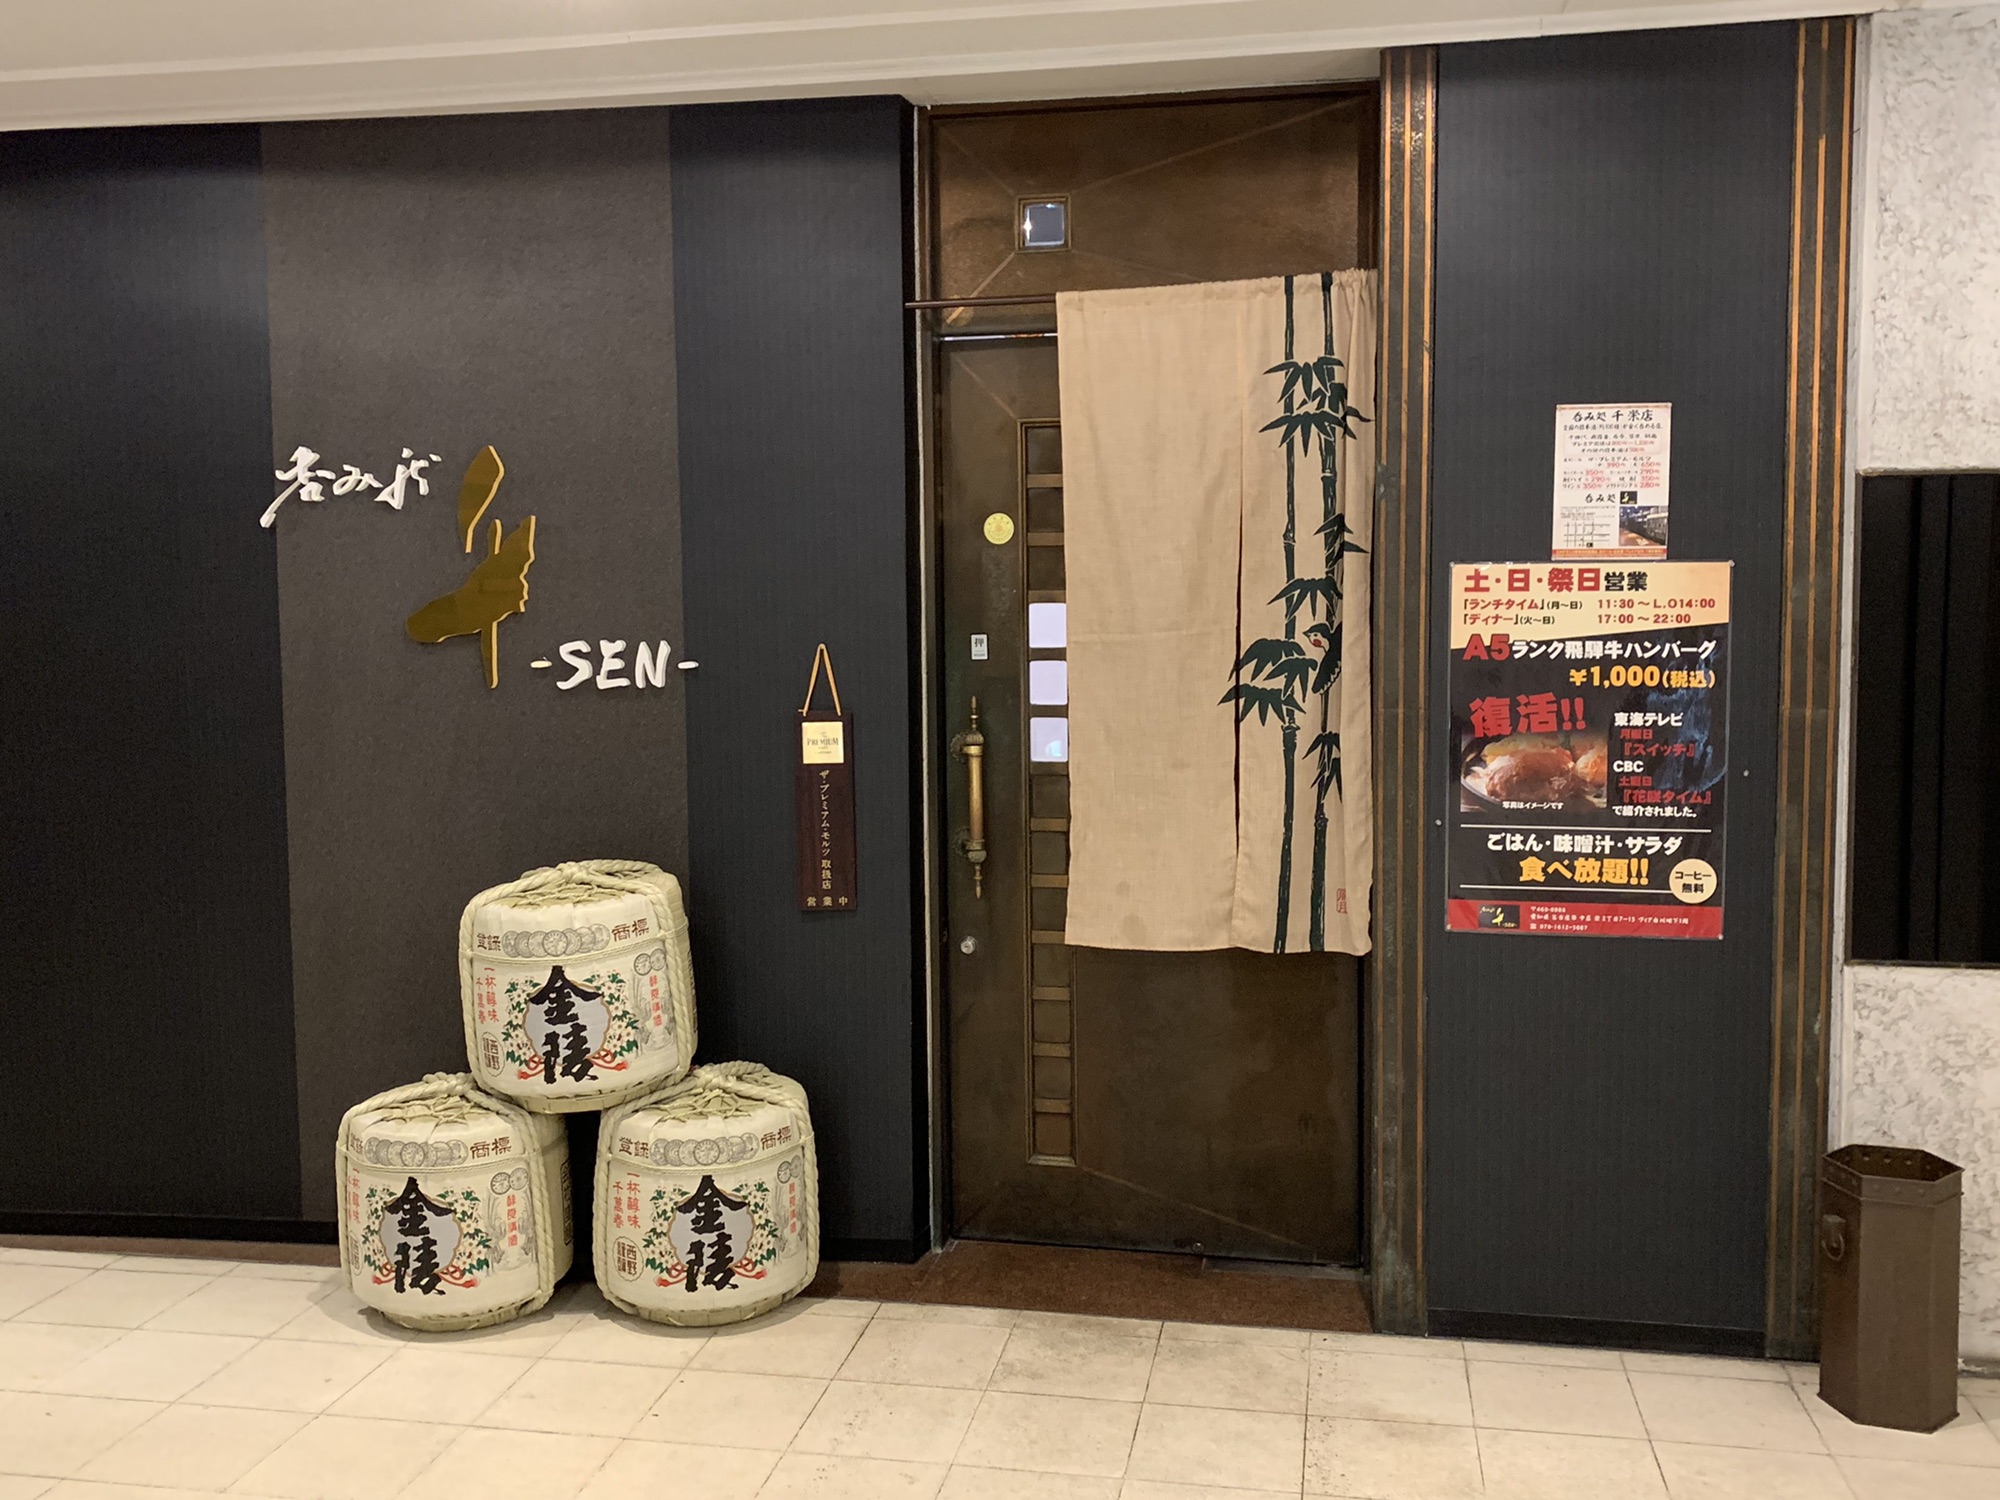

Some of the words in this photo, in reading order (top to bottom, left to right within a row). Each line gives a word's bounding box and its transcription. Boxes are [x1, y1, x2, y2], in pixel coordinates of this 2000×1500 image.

[1464, 568, 1648, 592] 土・日・祭日営業
[1598, 599, 1634, 609] 11:30
[1598, 614, 1634, 624] 17:00
[1653, 613, 1691, 624] 22:00
[1469, 692, 1586, 738] 復活!!
[1614, 712, 1684, 726] 東海テレビ
[1613, 760, 1644, 773] CBC
[1502, 801, 1564, 810] 写真はイメージです
[1612, 806, 1698, 818] で紹介されました。
[1487, 832, 1683, 856] ごはん・味噌汁・サラダ
[1519, 856, 1649, 885] 食べ放題!!
[1675, 871, 1712, 880] コーヒー
[1681, 883, 1704, 893] 無料
[806, 896, 849, 907] 営業中
[470, 1137, 511, 1160] 商標
